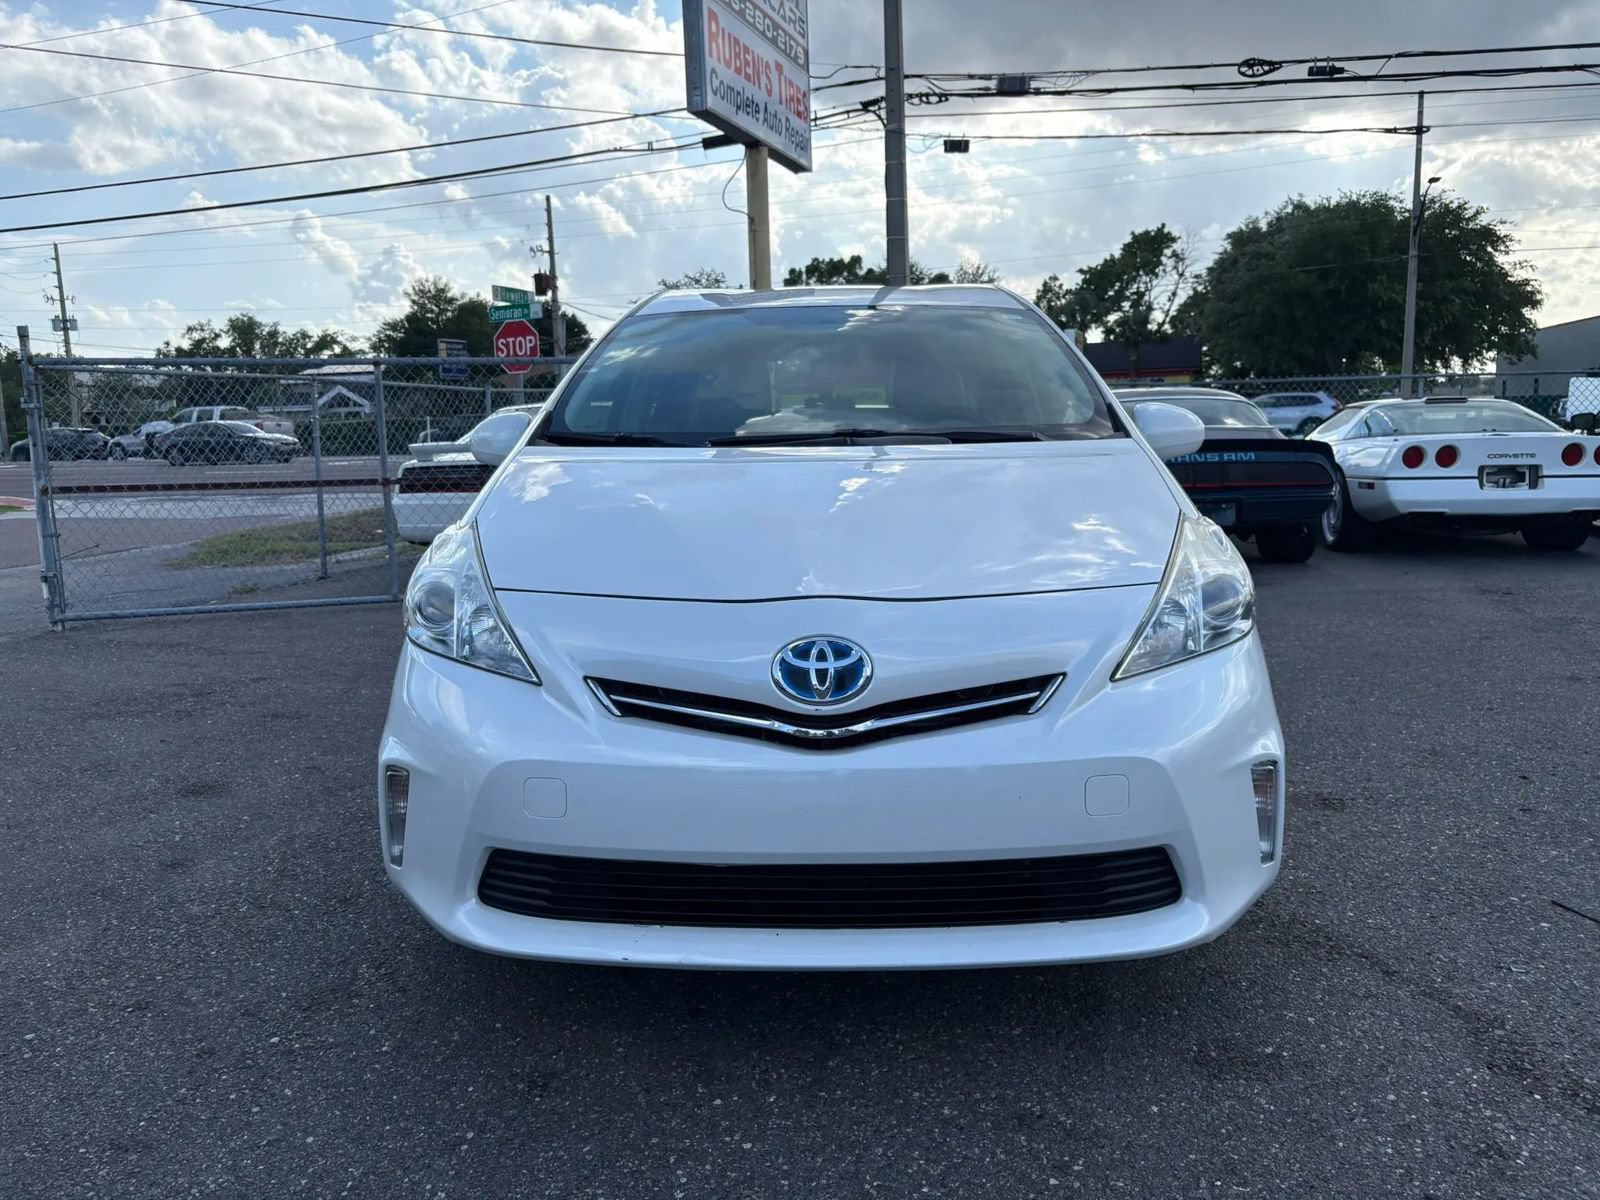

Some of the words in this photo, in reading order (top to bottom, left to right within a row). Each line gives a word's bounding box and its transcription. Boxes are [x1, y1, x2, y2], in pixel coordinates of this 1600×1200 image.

[710, 67, 760, 123] Complete
[762, 102, 784, 137] Auto
[785, 116, 809, 153] Repair
[491, 308, 523, 320] Semoran
[498, 336, 536, 357] STOP
[1164, 452, 1219, 462] ANS
[1223, 452, 1256, 461] AM
